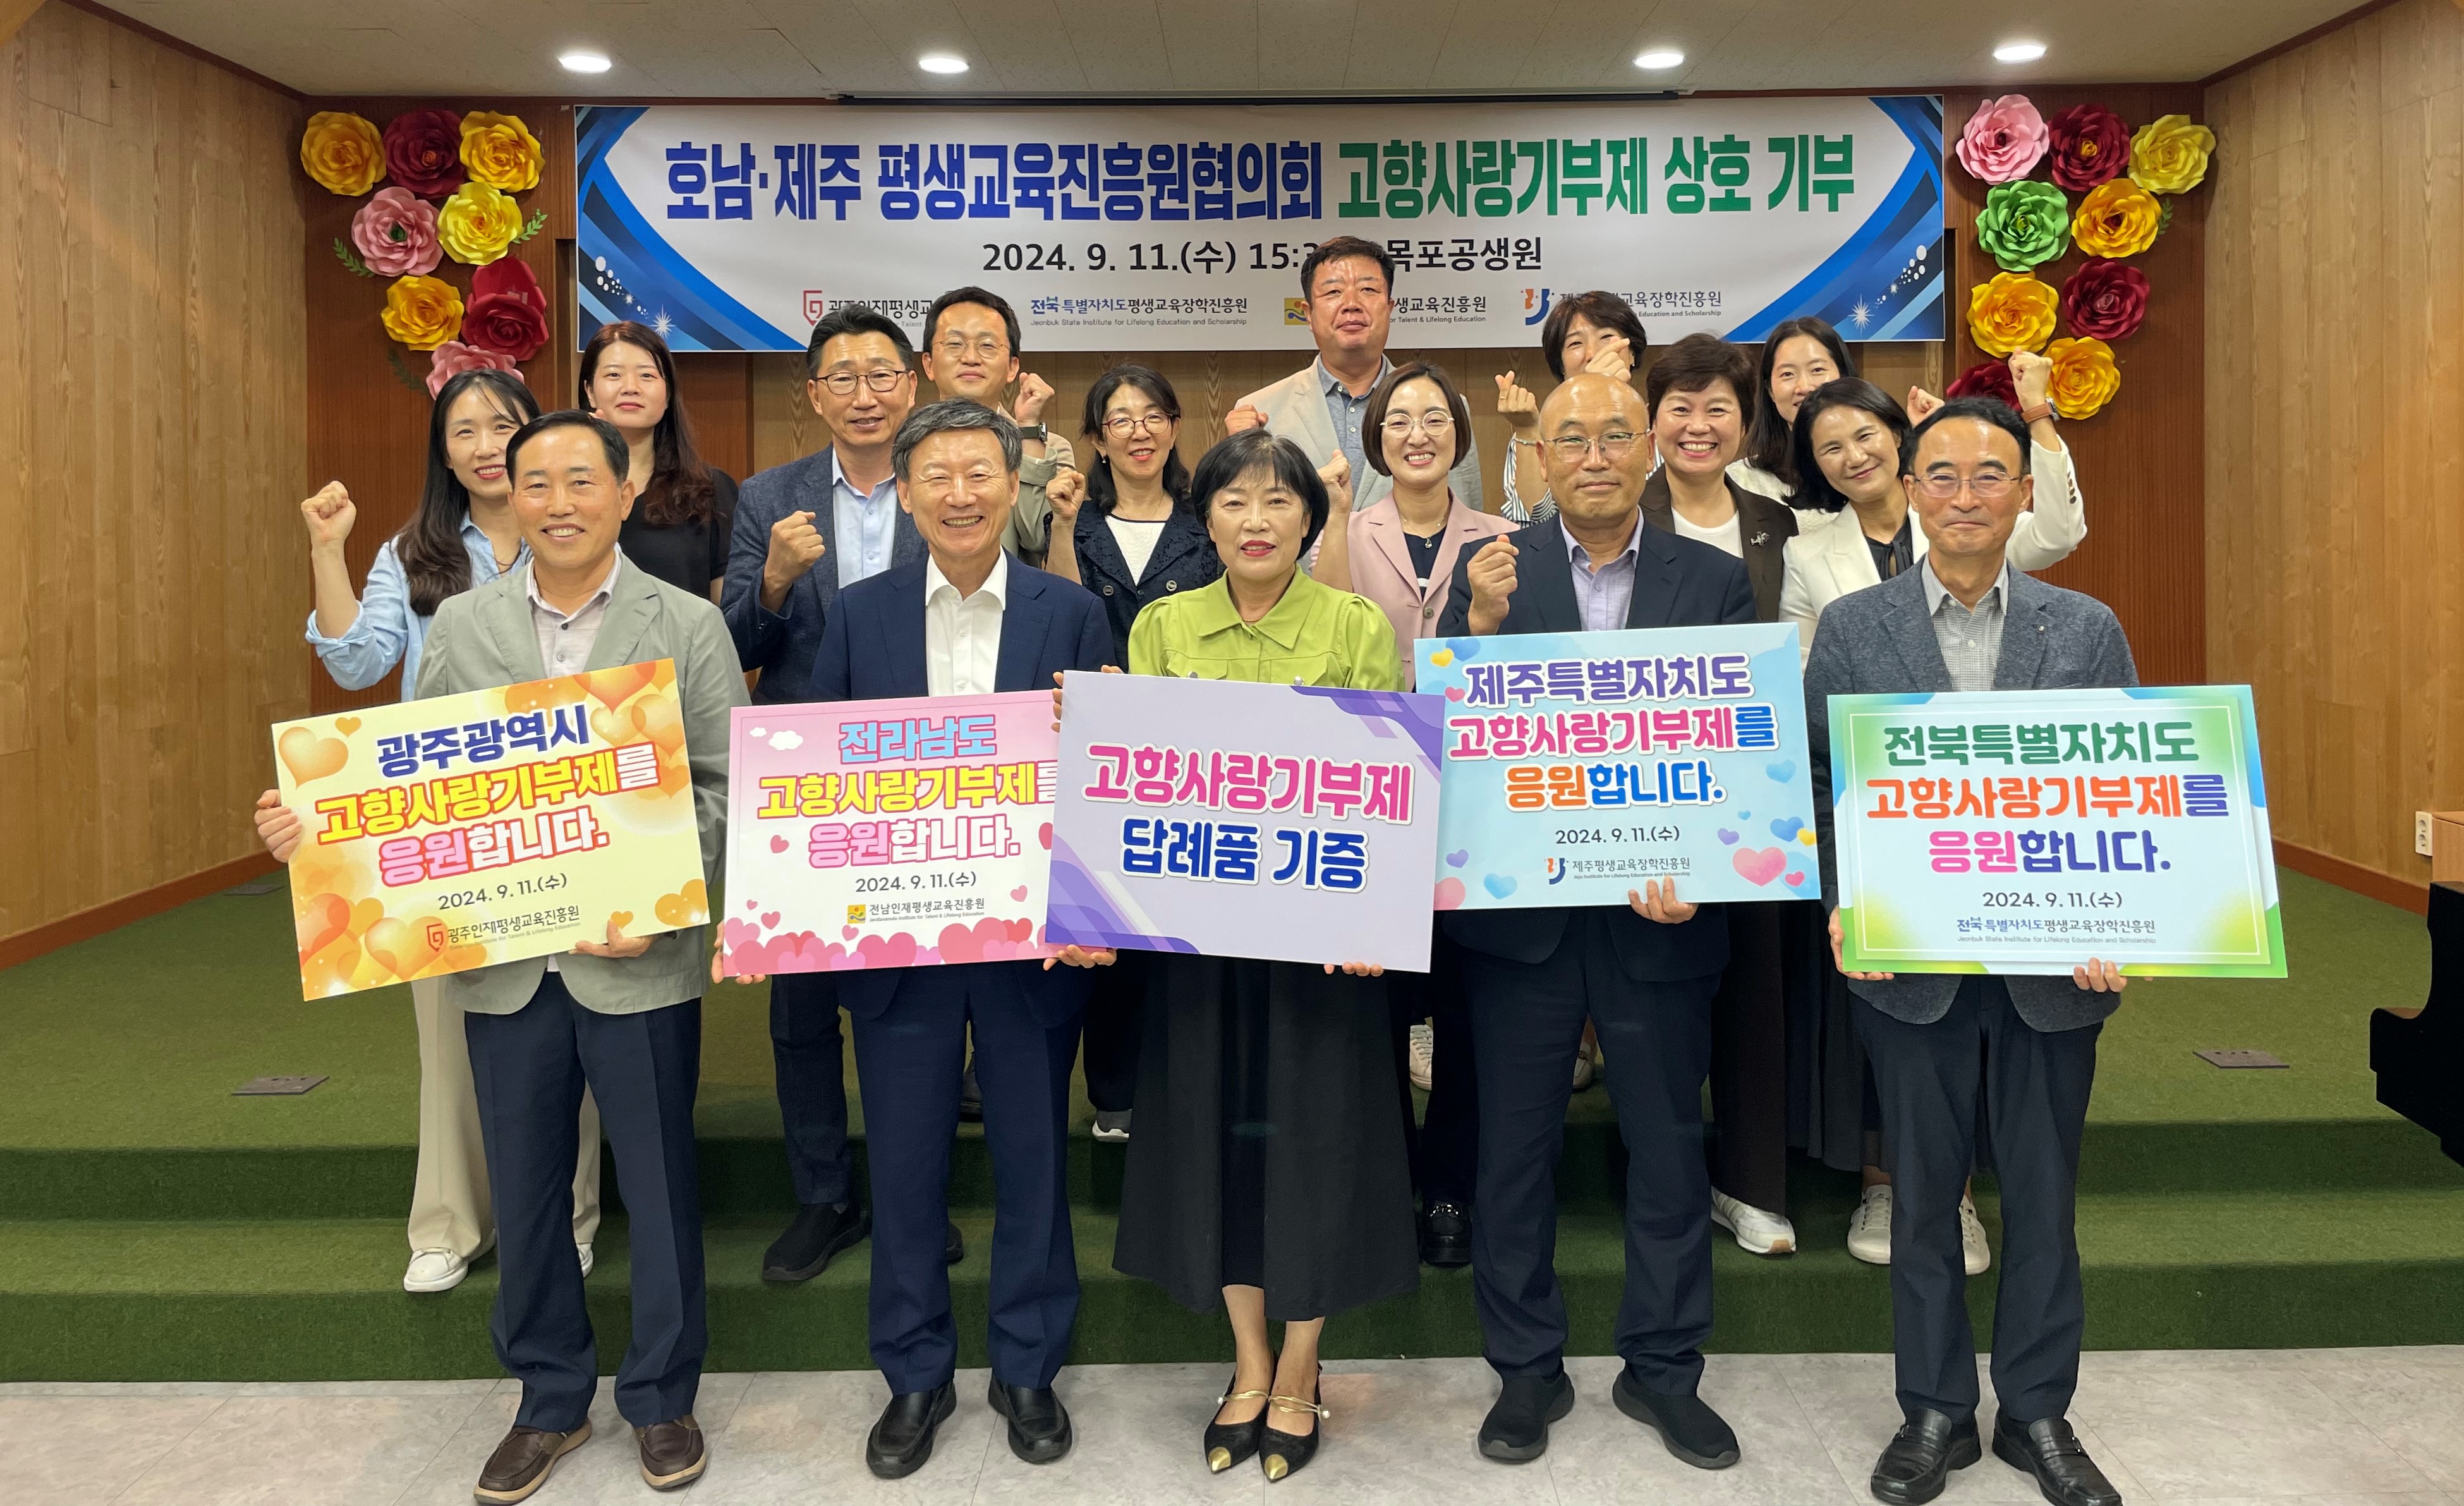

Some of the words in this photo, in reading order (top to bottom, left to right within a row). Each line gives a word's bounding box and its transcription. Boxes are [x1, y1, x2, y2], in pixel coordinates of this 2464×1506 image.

[665, 140, 862, 221] 호남·제주
[877, 140, 1322, 221] 평생교육진흥원협의회
[1338, 136, 1648, 219] 고향사랑기부제
[1664, 132, 1752, 215] 상호
[1767, 133, 1855, 214] 기부
[983, 243, 1075, 271] 2024.
[1087, 243, 1115, 271] 9.
[1128, 241, 1237, 274] 11.(수)
[1126, 319, 1155, 327] Lifelong
[1208, 318, 1247, 326] Scholarship
[1426, 316, 1452, 324] Lifelong
[1464, 655, 1752, 707] 제주특별자치도
[377, 705, 590, 779] 광주광역시
[840, 714, 997, 765] 전라남도
[1447, 705, 1778, 758] 고향사랑기부제를
[1883, 721, 2200, 767] 전북특별자치도
[315, 741, 660, 846] 고향사랑기부제를
[1084, 744, 1412, 822] 고향사랑기부제
[1505, 760, 1724, 810] 응원합니다.
[1866, 774, 2230, 819] 고향사랑기부제를
[379, 805, 610, 887] 응원합니다.
[808, 814, 1021, 869] 응원합니다.
[1122, 818, 1259, 881] 답례품
[1271, 829, 1366, 889] 기증
[1555, 829, 1607, 844] 2024.
[1611, 828, 1627, 843] 9.
[1631, 825, 1680, 842] 11.(수)
[1929, 829, 2171, 874] 응원합니다.
[855, 876, 906, 892] 2024.
[910, 875, 926, 889] 9.
[930, 871, 976, 889] 11.(수)
[1572, 857, 1690, 873] 제주평생교육장학진흥원
[438, 888, 492, 910] 2024.
[497, 884, 514, 899] 9.
[517, 872, 567, 896] 11.(수)
[869, 897, 985, 916] 전남인재평생교육진흥원
[1982, 892, 2041, 908] 2024.
[2045, 892, 2063, 908] 9.
[2067, 891, 2123, 908] 11.(수)
[447, 904, 580, 944] 광주인재평생교육진흥원
